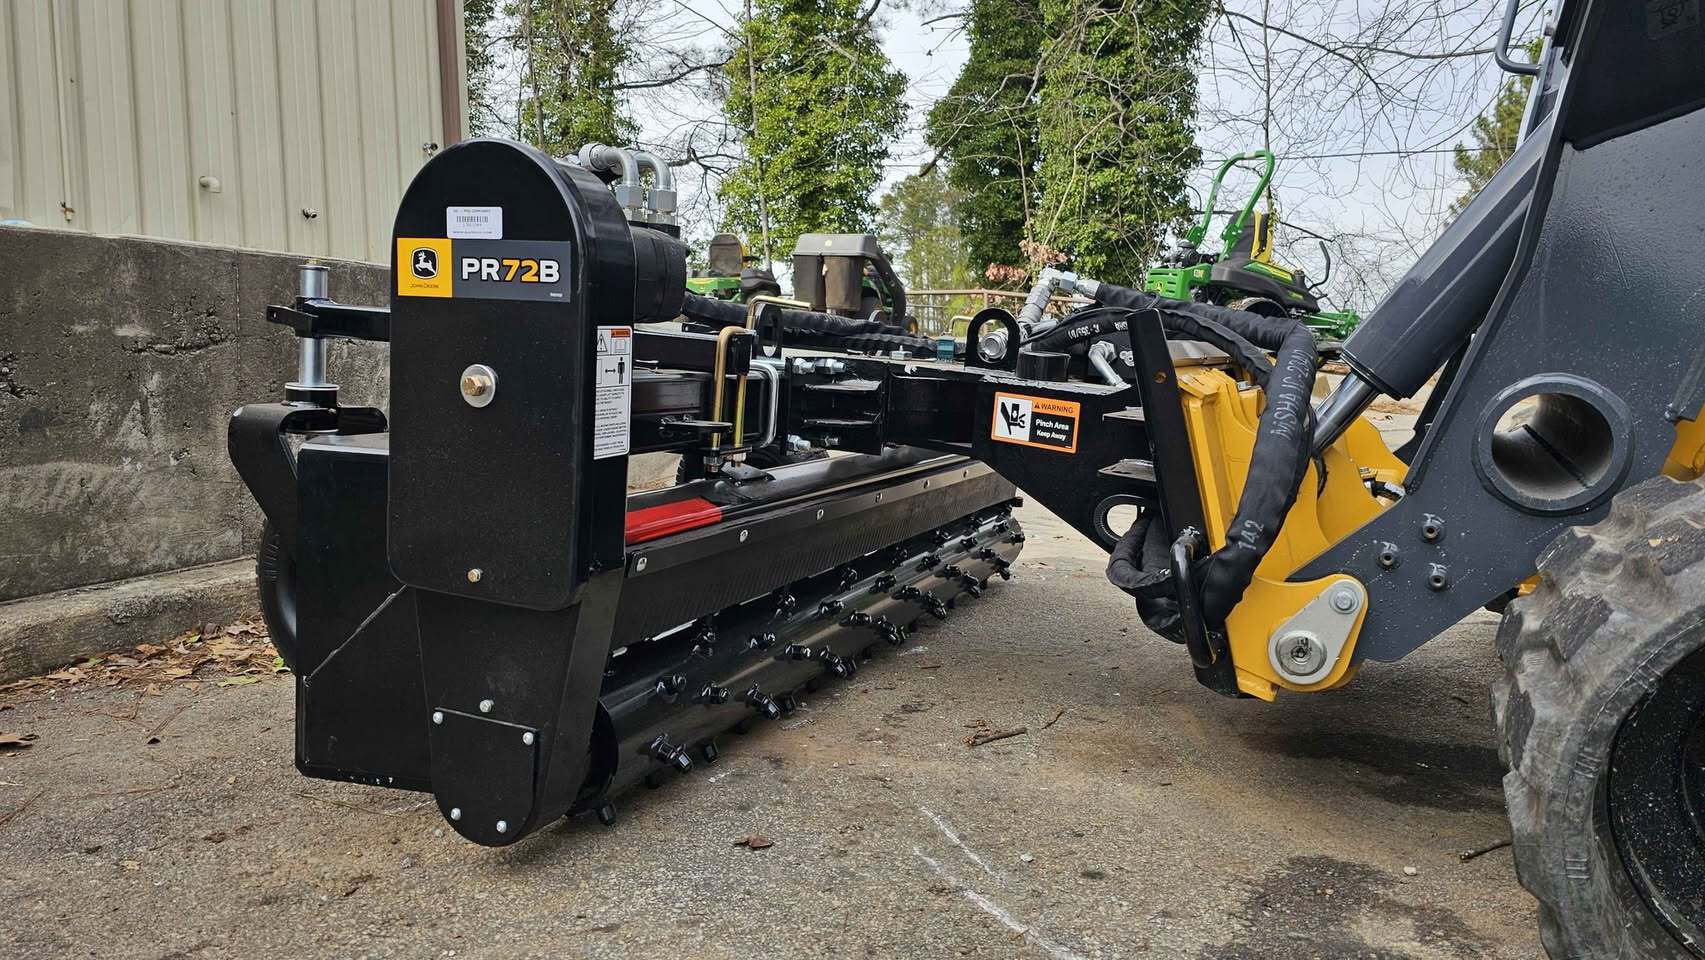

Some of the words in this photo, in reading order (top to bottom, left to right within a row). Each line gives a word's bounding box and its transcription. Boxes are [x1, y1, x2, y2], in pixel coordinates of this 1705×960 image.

[461, 257, 560, 283] PR72B
[1041, 403, 1074, 414] WARNING
[1035, 418, 1054, 428] Pinch
[1054, 421, 1069, 431] Area
[1036, 429, 1050, 439] Keep
[1050, 431, 1067, 442] Away
